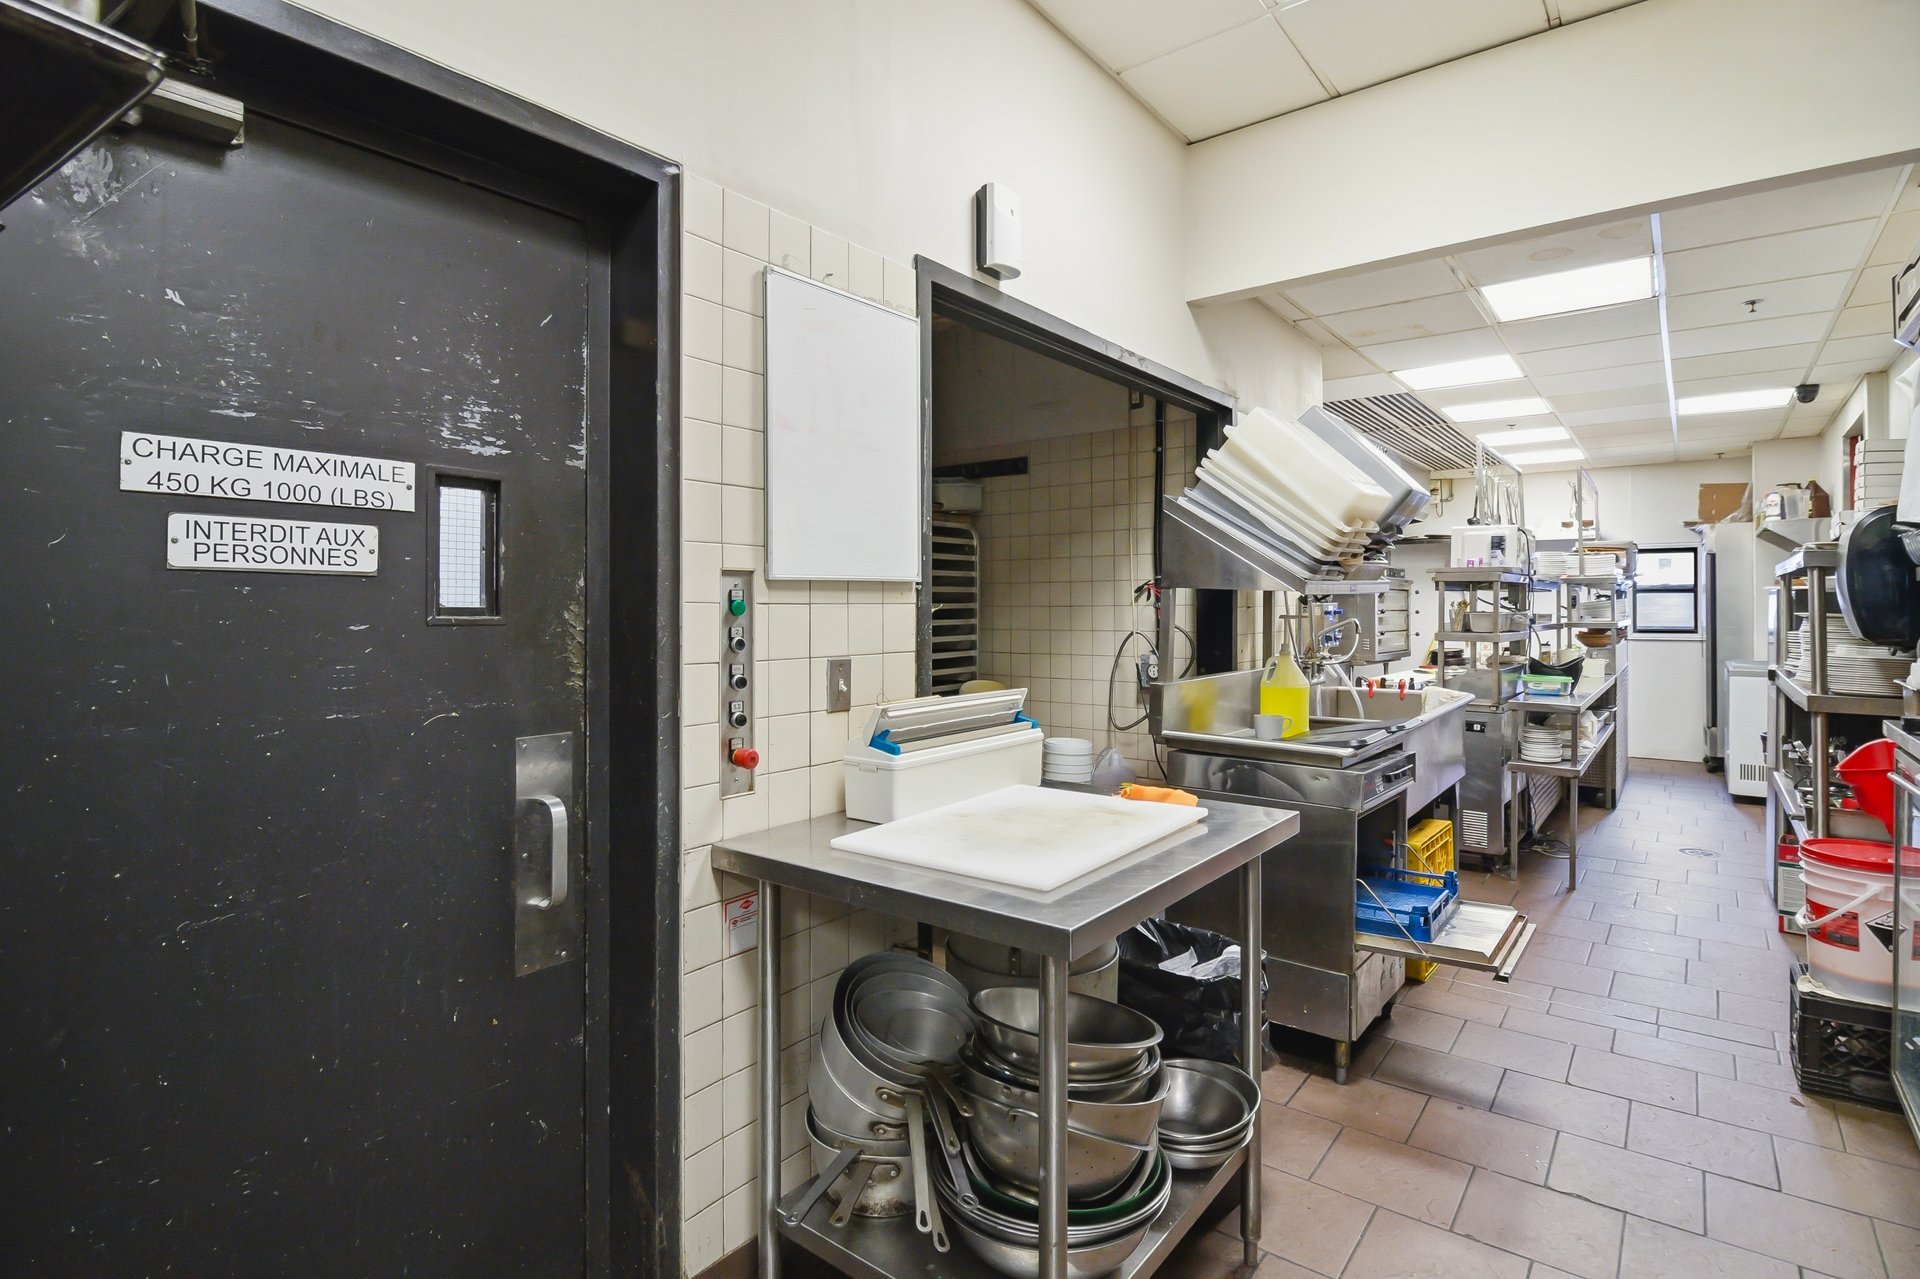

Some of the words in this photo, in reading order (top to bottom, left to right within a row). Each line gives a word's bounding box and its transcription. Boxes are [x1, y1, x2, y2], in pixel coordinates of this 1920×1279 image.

[132, 437, 263, 469] CHARGE
[273, 452, 407, 484] MAXIMALE
[146, 470, 200, 493] 450
[210, 475, 251, 497] KG
[263, 481, 322, 503] 1000
[330, 487, 394, 509] (LBS)
[185, 519, 311, 545] INTERDIT
[315, 527, 366, 548] AUX
[193, 542, 358, 567] PERSONNES
